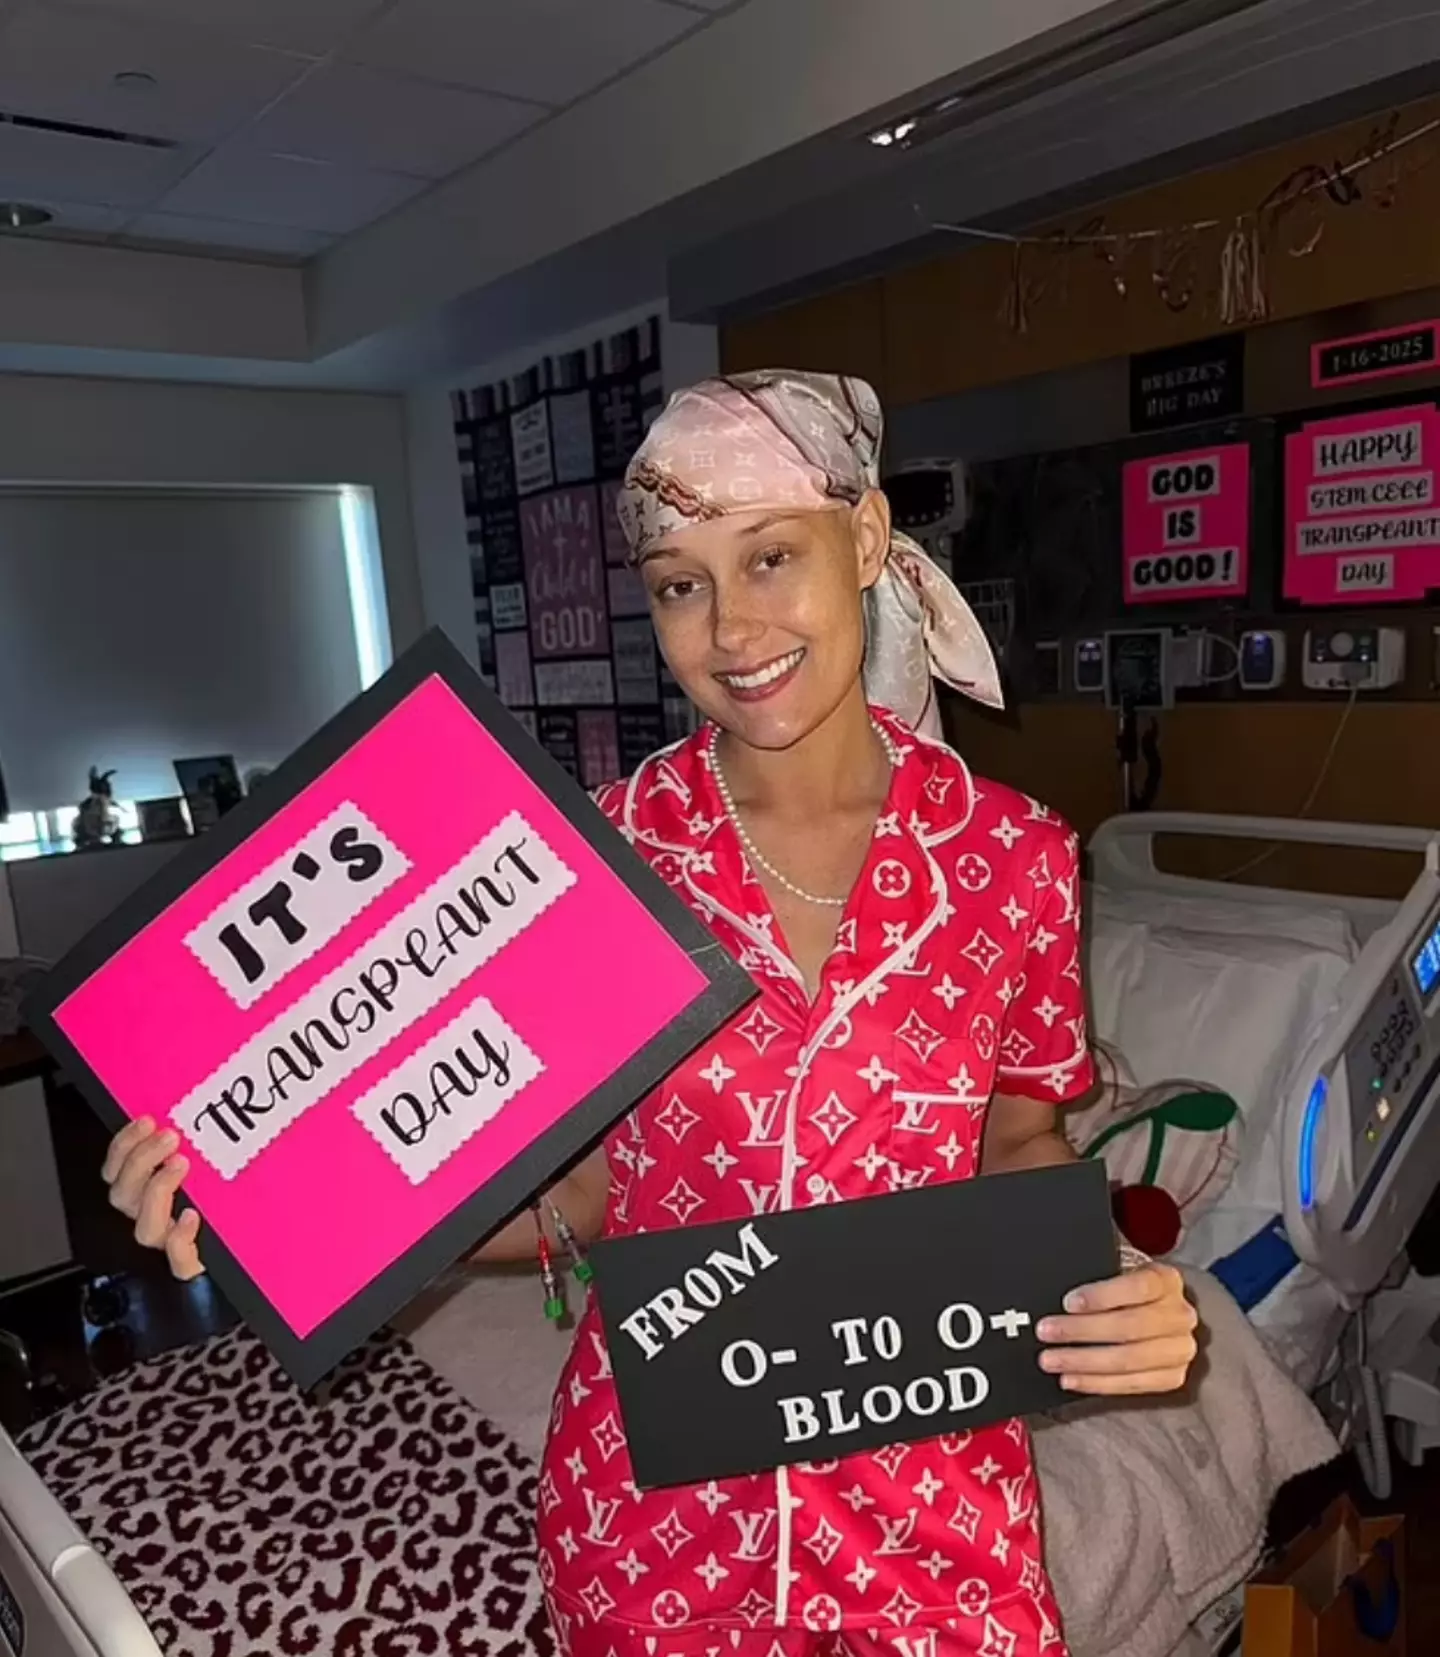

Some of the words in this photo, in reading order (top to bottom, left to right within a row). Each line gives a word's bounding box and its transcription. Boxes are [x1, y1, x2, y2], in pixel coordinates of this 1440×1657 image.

[1187, 386, 1222, 408] DAY
[1320, 430, 1417, 467] HAPPY
[1152, 464, 1215, 495] GOD
[1310, 486, 1366, 508] STEM
[1372, 478, 1428, 503] CELL
[1167, 510, 1195, 540] IS
[1342, 561, 1388, 585] DAY
[541, 606, 596, 650] GOD
[217, 827, 384, 984] IT'S
[193, 837, 540, 1144] TRANSPLANT
[380, 1028, 510, 1146] DAY
[721, 1339, 797, 1387] O-
[937, 1302, 1030, 1351] O+
[777, 1366, 990, 1443] BLOOD
